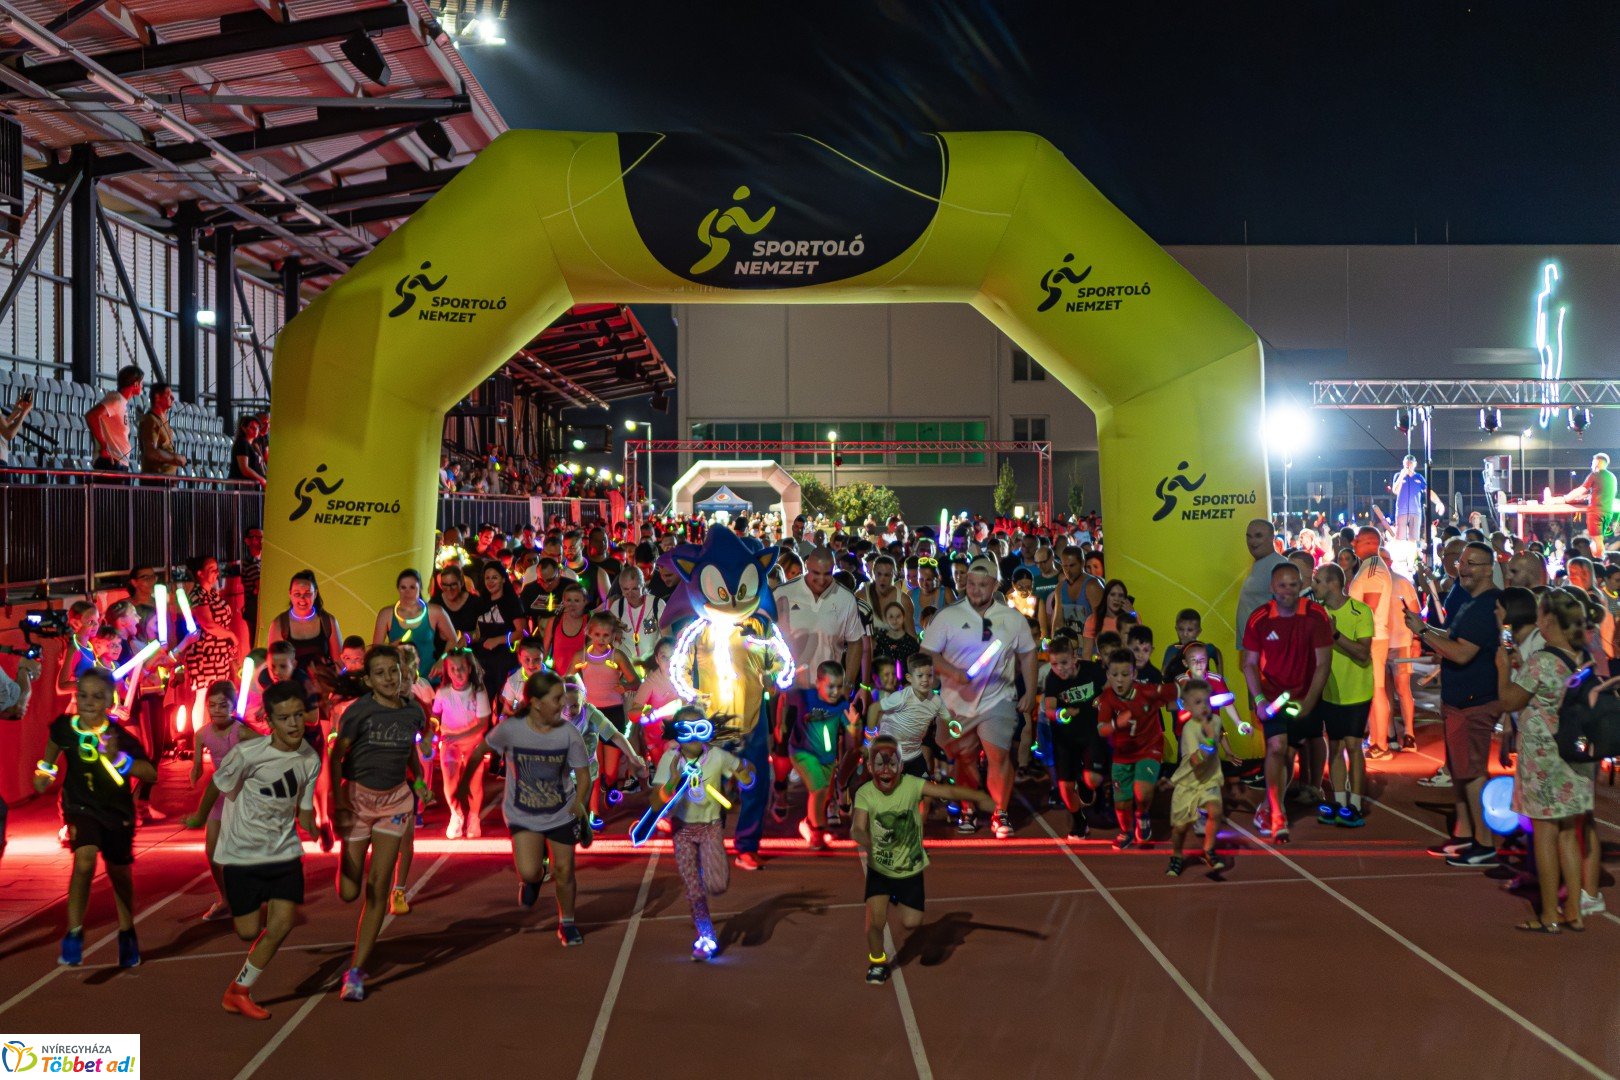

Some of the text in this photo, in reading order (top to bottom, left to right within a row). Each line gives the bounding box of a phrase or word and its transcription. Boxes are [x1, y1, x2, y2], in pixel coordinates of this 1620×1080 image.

[752, 233, 865, 257] SPORTOLÓ
[734, 260, 820, 275] NEMZET
[1077, 282, 1151, 298] SPORTOLÓ
[431, 296, 507, 310] SPORTOLÓ
[1065, 300, 1123, 313] NEMZET
[418, 309, 476, 323] NEMZET
[1192, 490, 1256, 506] SPORTOLÓ
[326, 499, 401, 513] SPORTOLÓ
[314, 513, 371, 526] NEMZET
[1181, 508, 1235, 520] NEMZET
